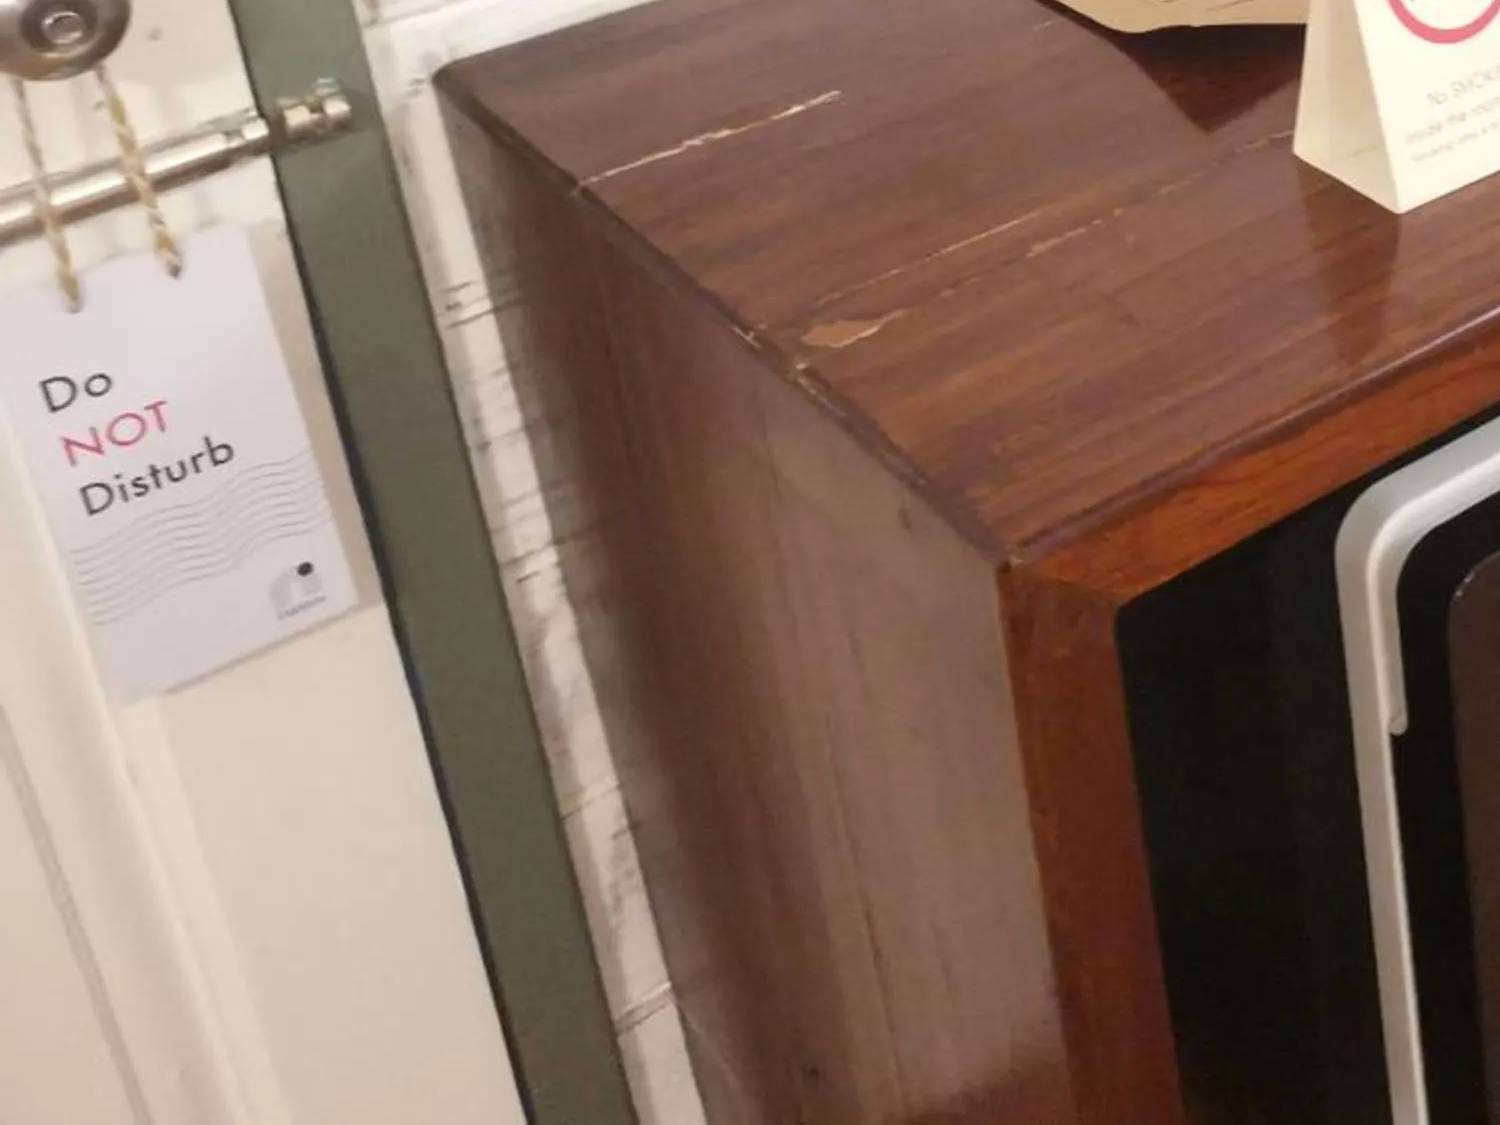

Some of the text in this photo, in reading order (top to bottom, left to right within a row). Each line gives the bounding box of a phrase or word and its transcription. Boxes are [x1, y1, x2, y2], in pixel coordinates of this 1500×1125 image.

[38, 372, 114, 414] Do
[59, 400, 169, 467] NOT
[78, 435, 236, 517] Disturb
